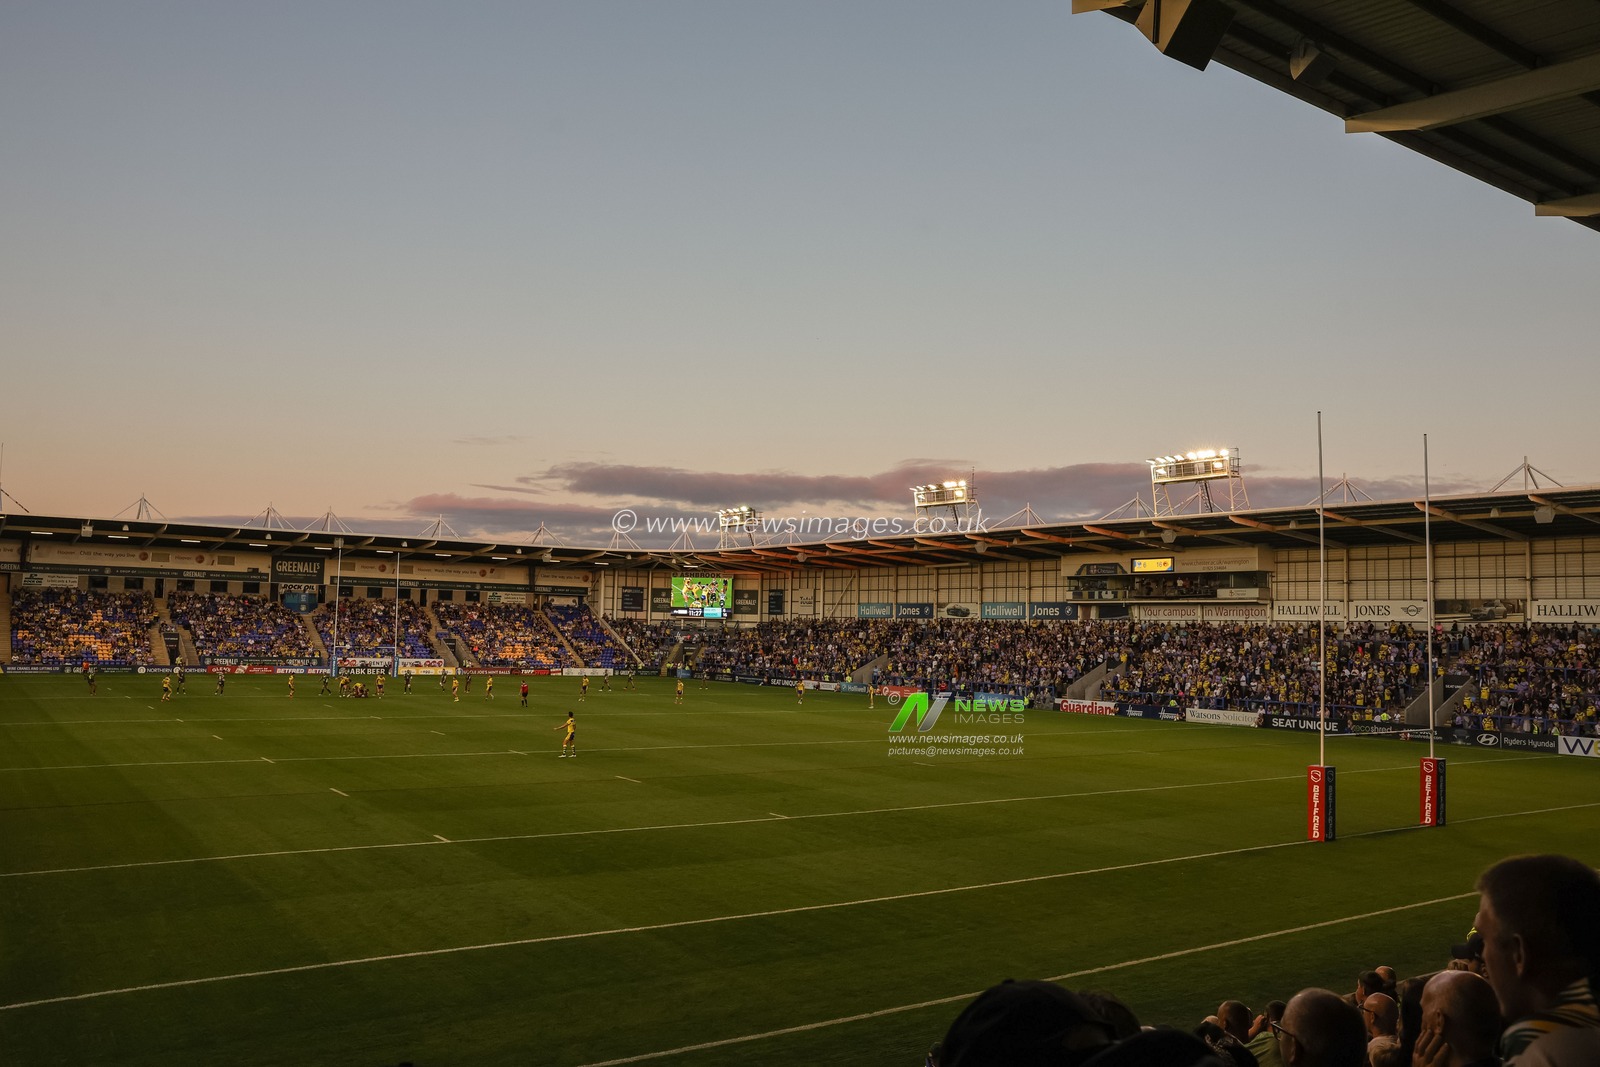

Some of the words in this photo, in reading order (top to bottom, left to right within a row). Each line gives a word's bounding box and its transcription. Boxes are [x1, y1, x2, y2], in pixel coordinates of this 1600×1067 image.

[860, 606, 891, 615] Halliwell
[898, 606, 920, 616] Jones
[984, 605, 1023, 615] Halliwell
[1032, 605, 1060, 616] Jones
[1143, 607, 1161, 616] Your
[1163, 608, 1196, 618] campus
[1205, 606, 1213, 616] in
[1215, 606, 1267, 619] Warrington
[1277, 605, 1340, 616] HALLIWELL
[1355, 605, 1391, 618] JONES
[1060, 700, 1112, 715] Guardian
[1189, 710, 1221, 720] Watsons
[1223, 712, 1257, 723] Solicitor
[1272, 717, 1298, 729] SEAT
[1299, 719, 1338, 732] UNIQUE
[1503, 737, 1527, 747] Ryders
[1528, 738, 1556, 748] Hyundai
[1424, 774, 1432, 824] BETFRED
[1312, 784, 1320, 839] BETFRED
